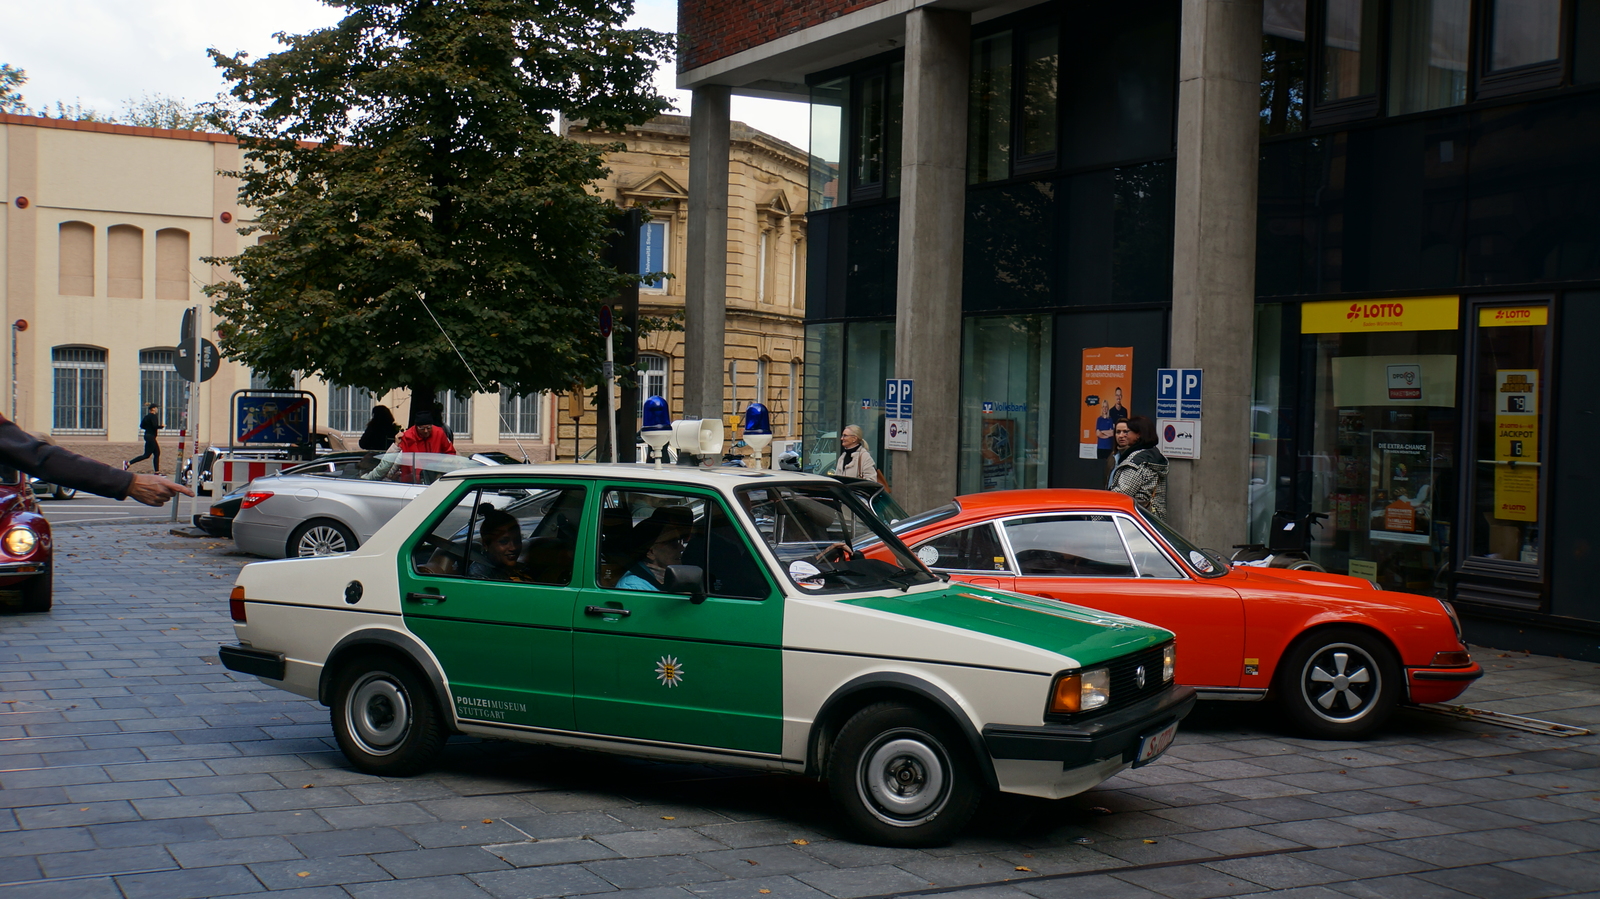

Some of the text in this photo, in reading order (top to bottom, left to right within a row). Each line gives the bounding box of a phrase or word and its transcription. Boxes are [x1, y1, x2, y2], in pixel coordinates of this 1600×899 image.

[1364, 303, 1403, 318] LOTTO
[1506, 310, 1530, 318] LOTTO
[1162, 374, 1173, 394] P
[1186, 374, 1198, 395] P
[1500, 383, 1534, 393] JACKPOT
[888, 383, 896, 400] P
[903, 383, 911, 400] P
[994, 402, 1027, 412] Volksbank
[1513, 398, 1525, 410] 79
[1515, 442, 1522, 455] 6
[457, 696, 526, 712] POLIZEIMUSEUM
[458, 706, 505, 720] STUTTGART
